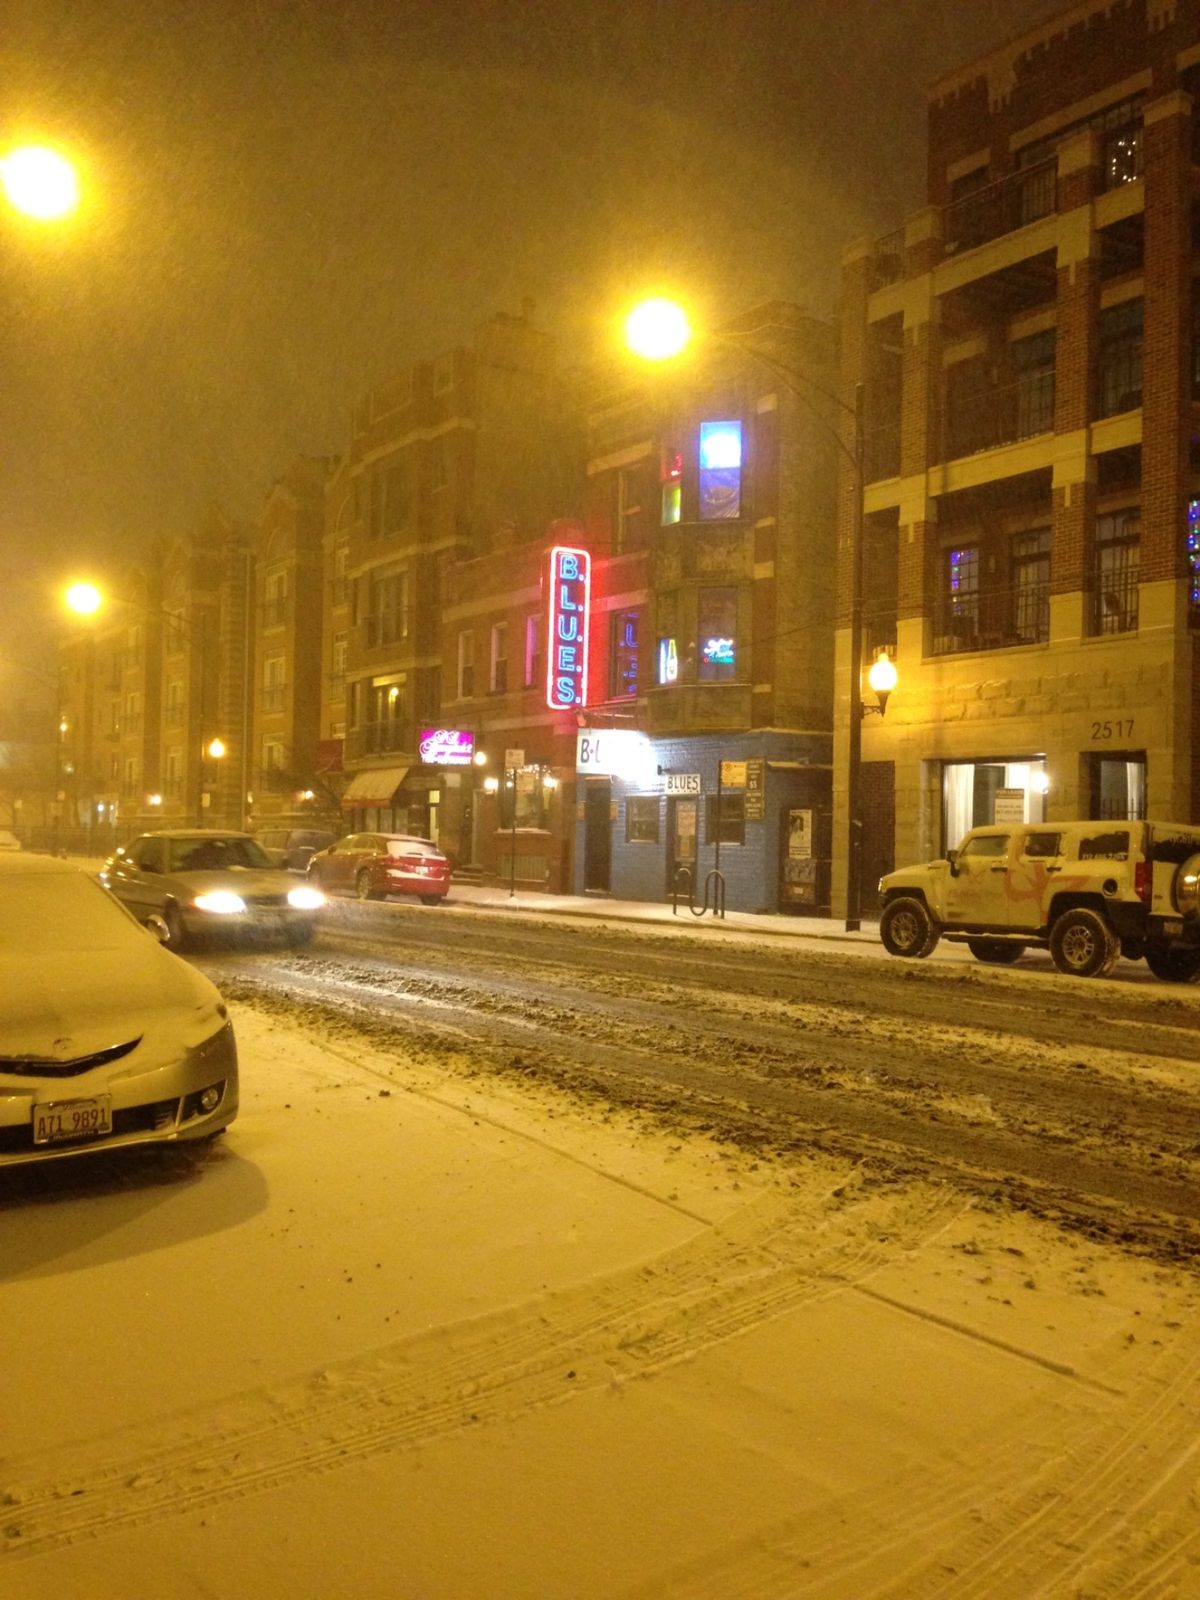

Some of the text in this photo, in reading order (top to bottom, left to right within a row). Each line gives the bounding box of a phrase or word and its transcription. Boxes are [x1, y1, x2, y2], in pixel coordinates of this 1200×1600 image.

[1091, 719, 1135, 740] 2517
[38, 1107, 105, 1137] A71 9891
